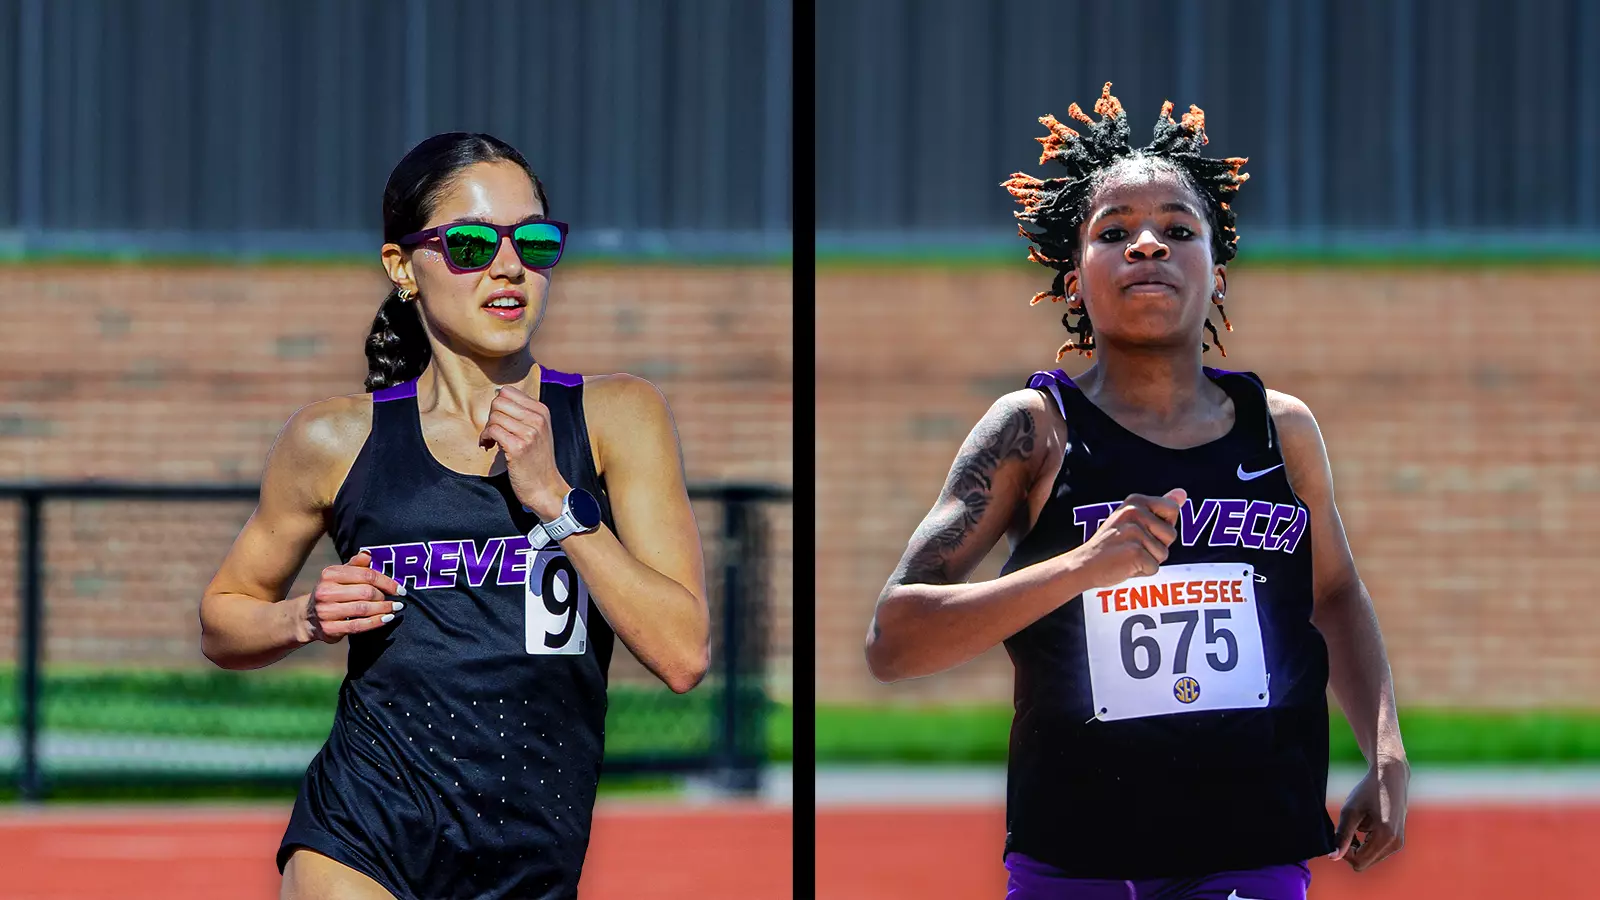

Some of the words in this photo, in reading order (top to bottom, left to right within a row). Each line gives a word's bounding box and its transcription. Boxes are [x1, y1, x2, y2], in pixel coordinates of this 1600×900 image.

[1073, 498, 1308, 554] TVECCA
[541, 555, 579, 649] 9
[1096, 580, 1244, 613] TENNESSEE
[1119, 608, 1239, 679] 675
[1174, 678, 1200, 703] SEC
